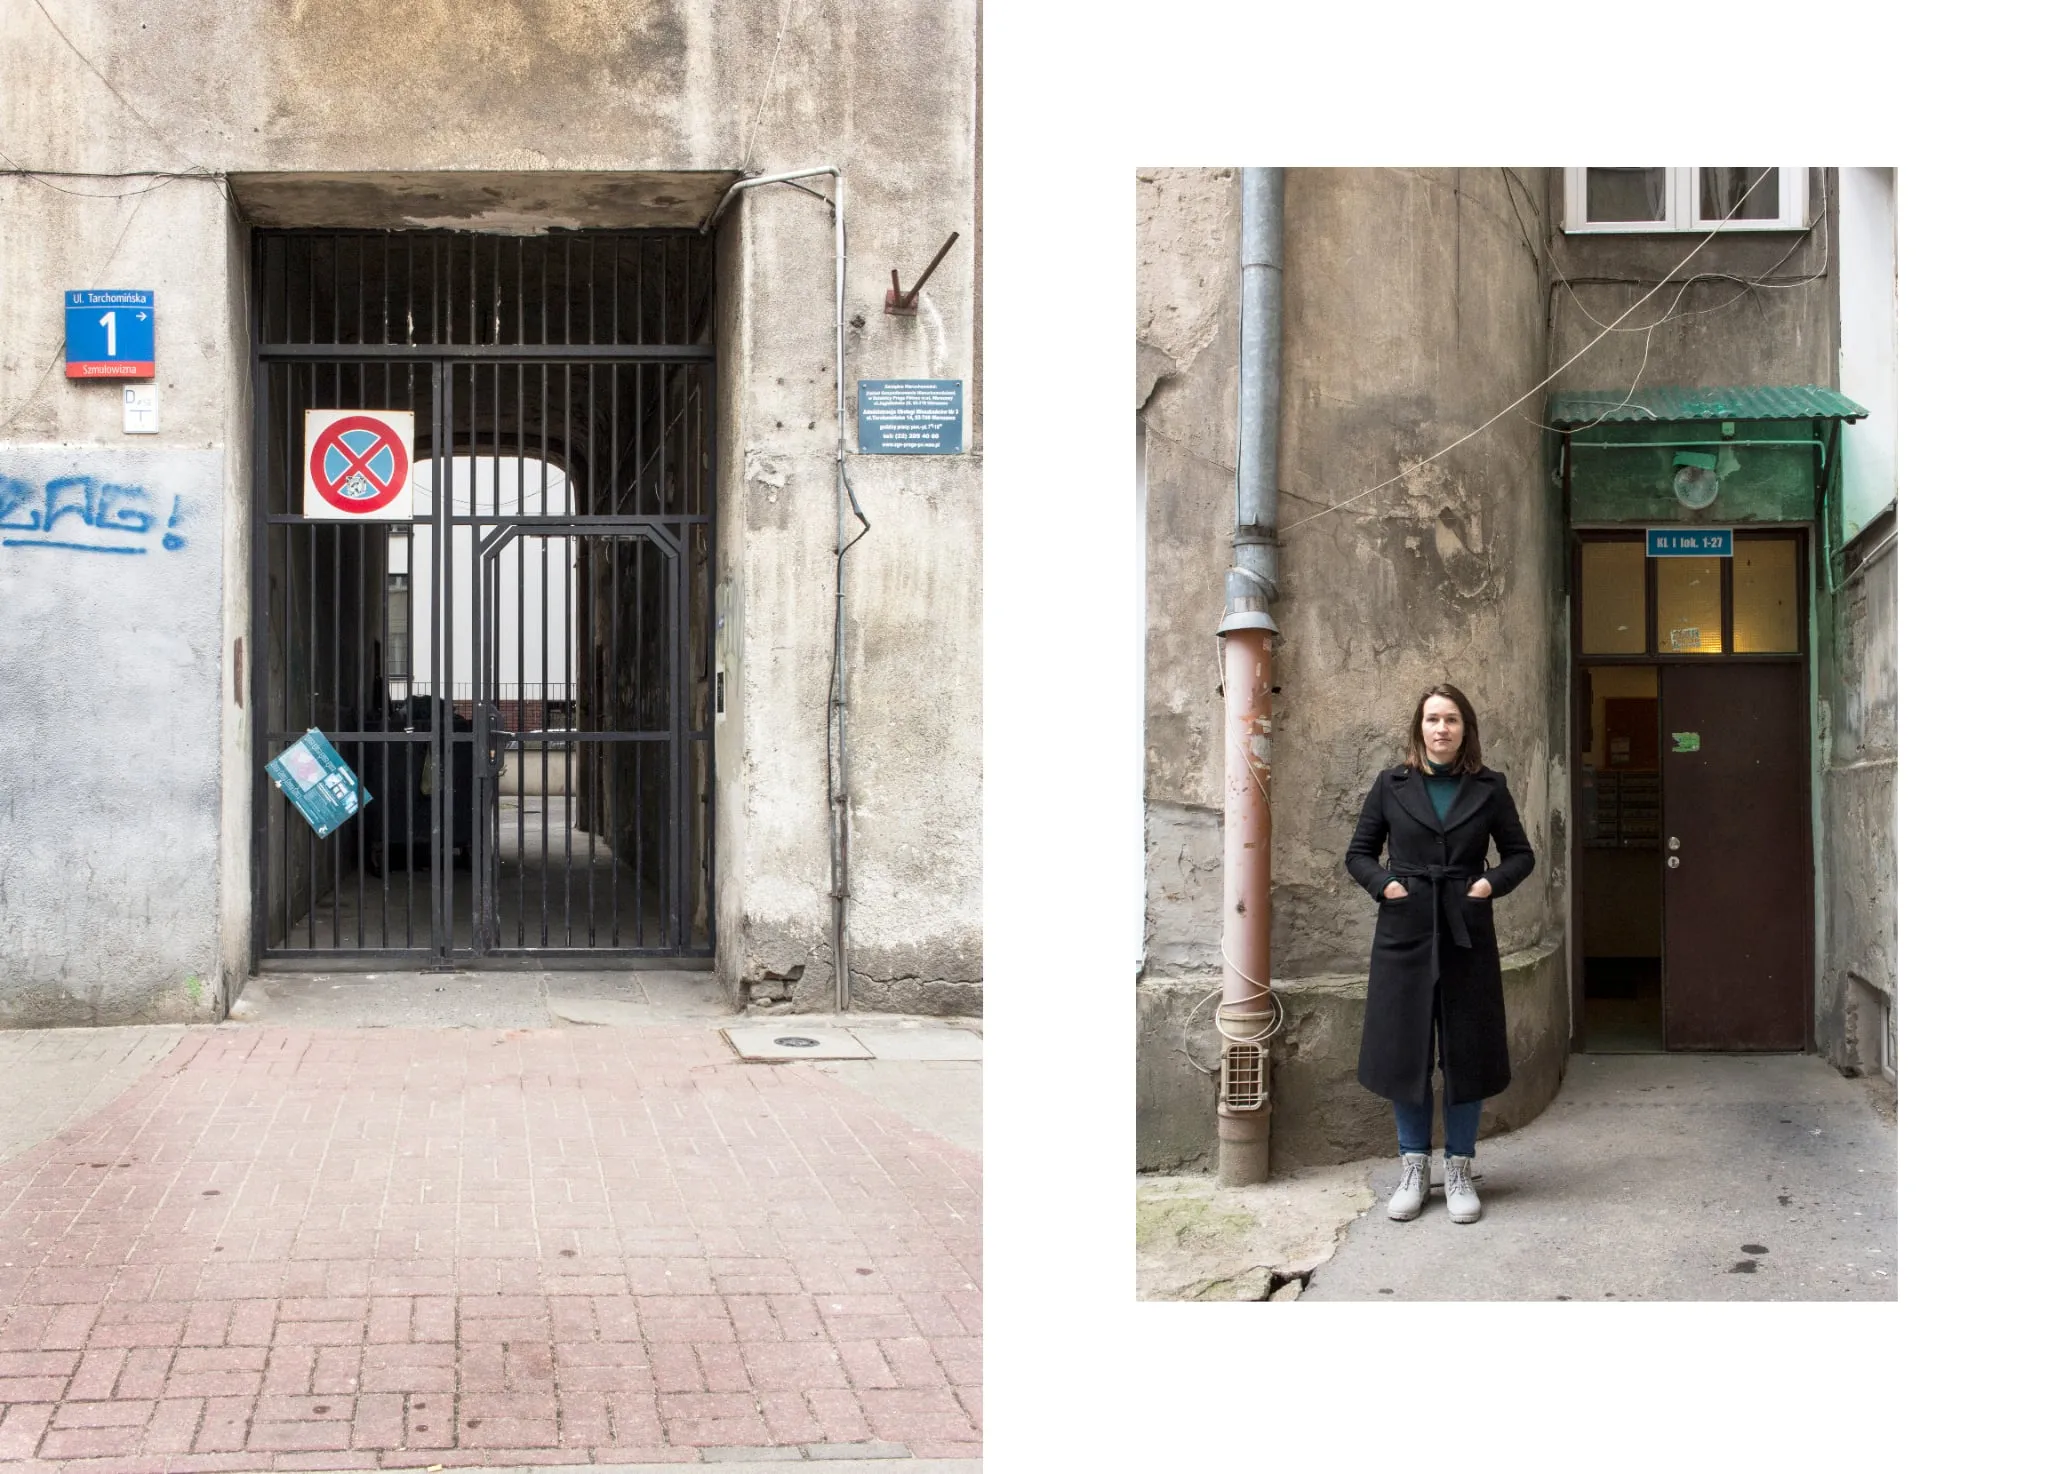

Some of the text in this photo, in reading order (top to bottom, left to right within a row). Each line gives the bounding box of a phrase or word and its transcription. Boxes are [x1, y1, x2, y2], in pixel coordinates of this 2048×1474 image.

[73, 293, 147, 304] Ul. Tarchomińska
[99, 311, 116, 356] 1
[1702, 537, 1722, 548] 1-27
